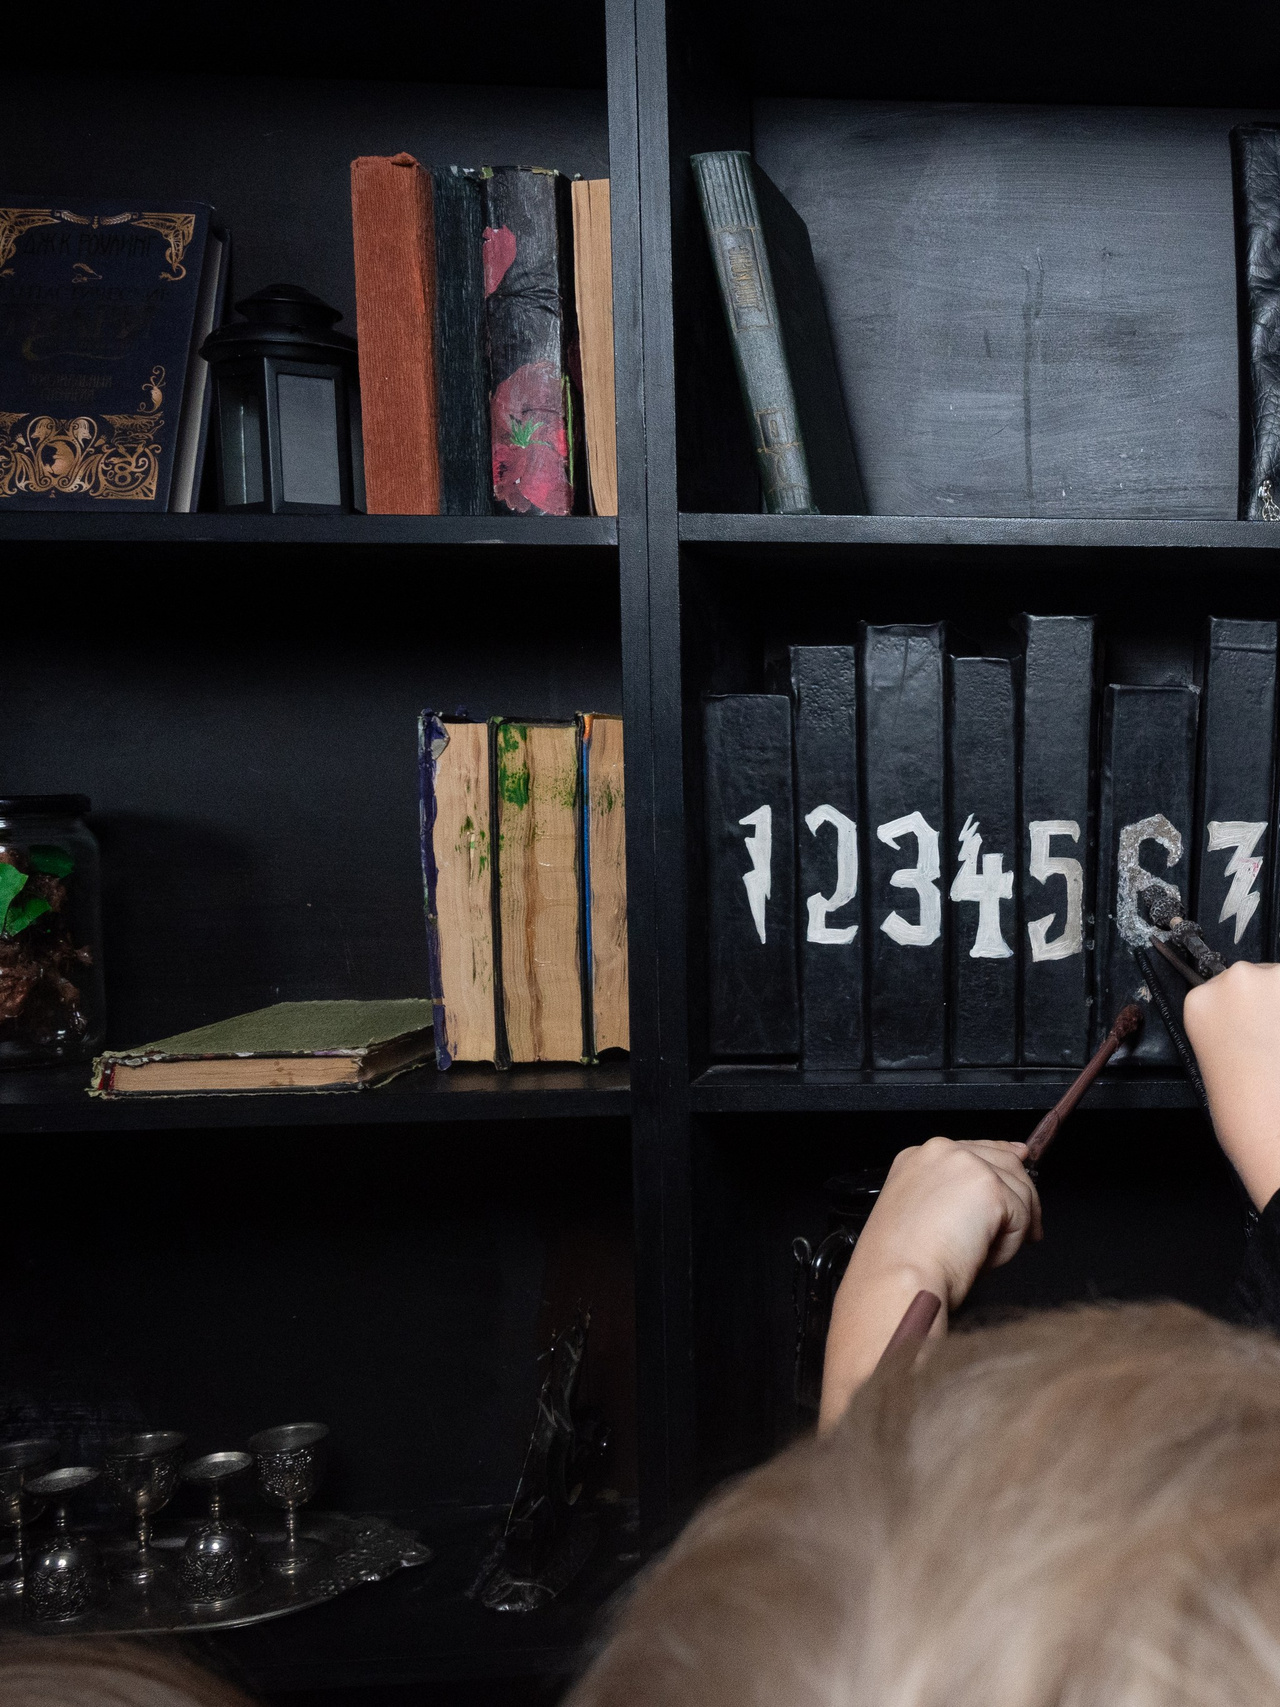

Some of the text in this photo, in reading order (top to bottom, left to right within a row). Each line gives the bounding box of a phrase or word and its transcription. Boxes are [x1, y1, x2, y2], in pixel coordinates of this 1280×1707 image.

[738, 804, 773, 945] 1
[804, 803, 859, 945] 2
[876, 810, 942, 947] 3
[949, 812, 1015, 959] 4
[1027, 819, 1084, 963] 5
[1117, 813, 1184, 948] 6
[1206, 820, 1269, 945] 7
